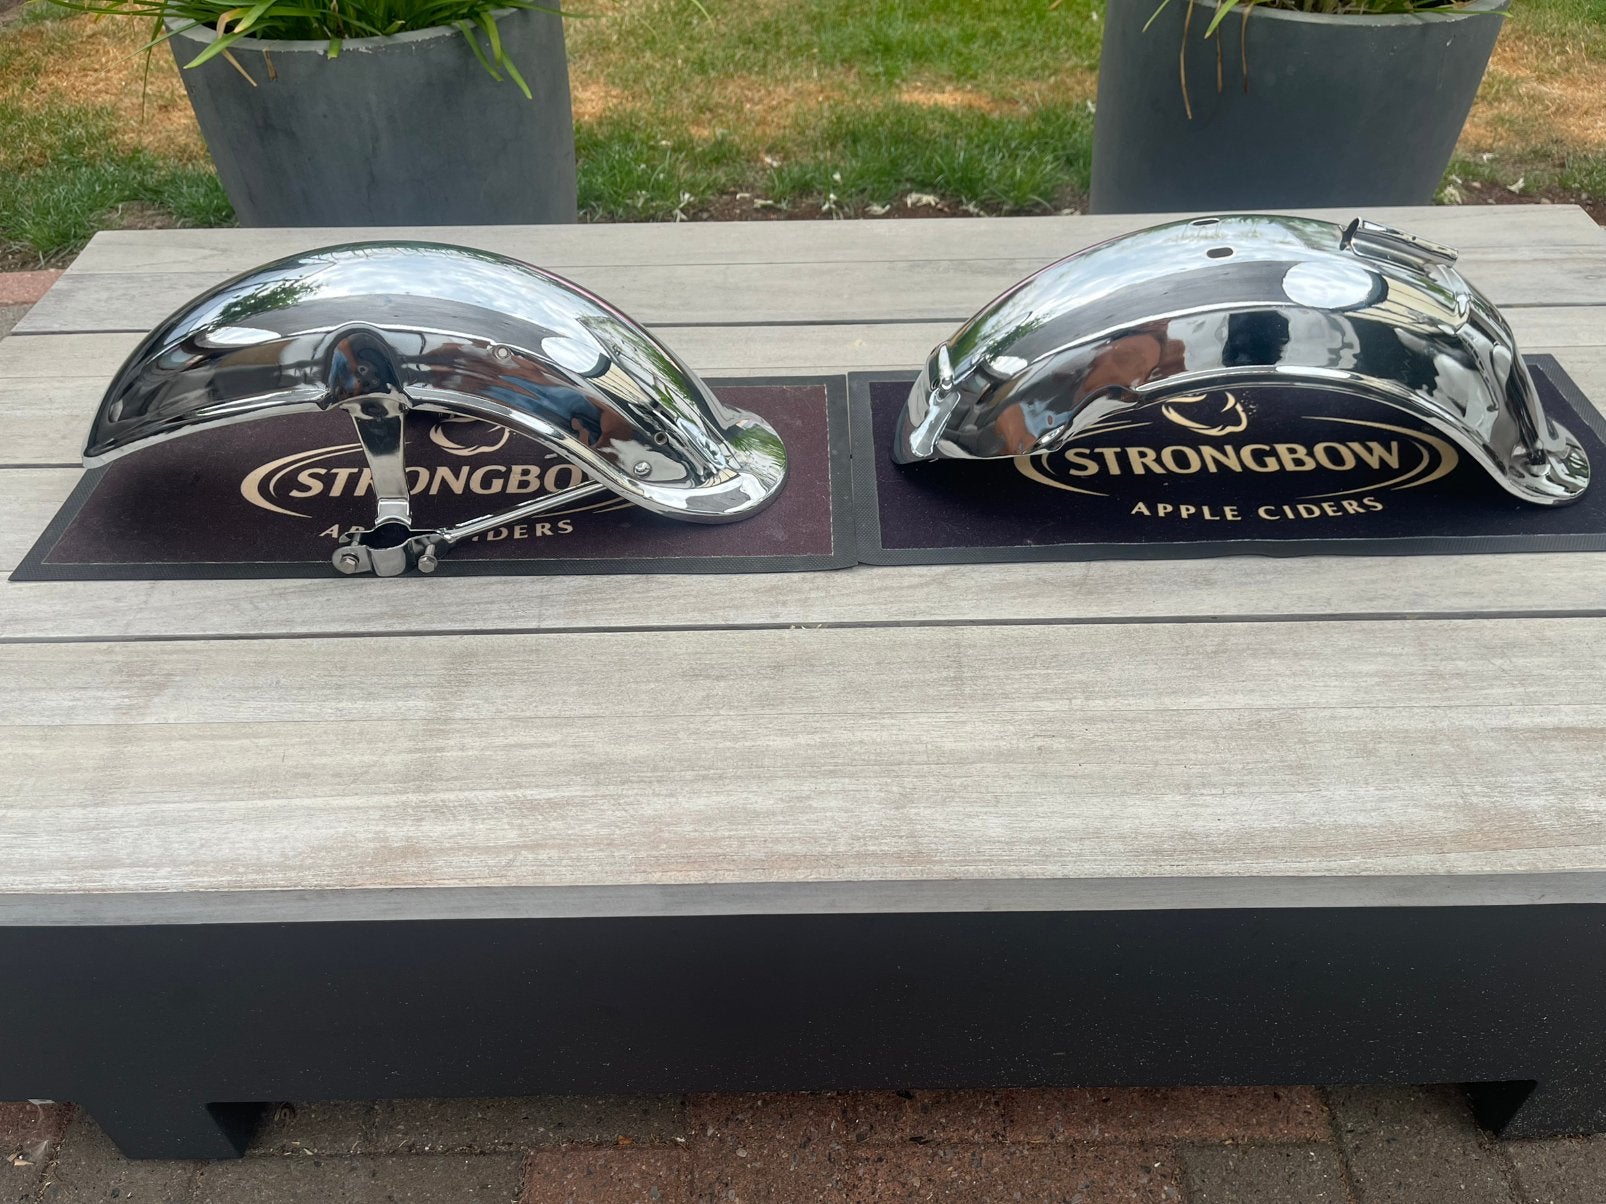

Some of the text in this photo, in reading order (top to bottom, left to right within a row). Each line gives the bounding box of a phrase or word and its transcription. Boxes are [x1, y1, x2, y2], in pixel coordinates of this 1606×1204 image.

[1068, 441, 1399, 476] STRONGBOW
[288, 463, 593, 498] STONGBO
[1130, 496, 1384, 521] APPLE CIDERS
[471, 519, 574, 542] DERS
